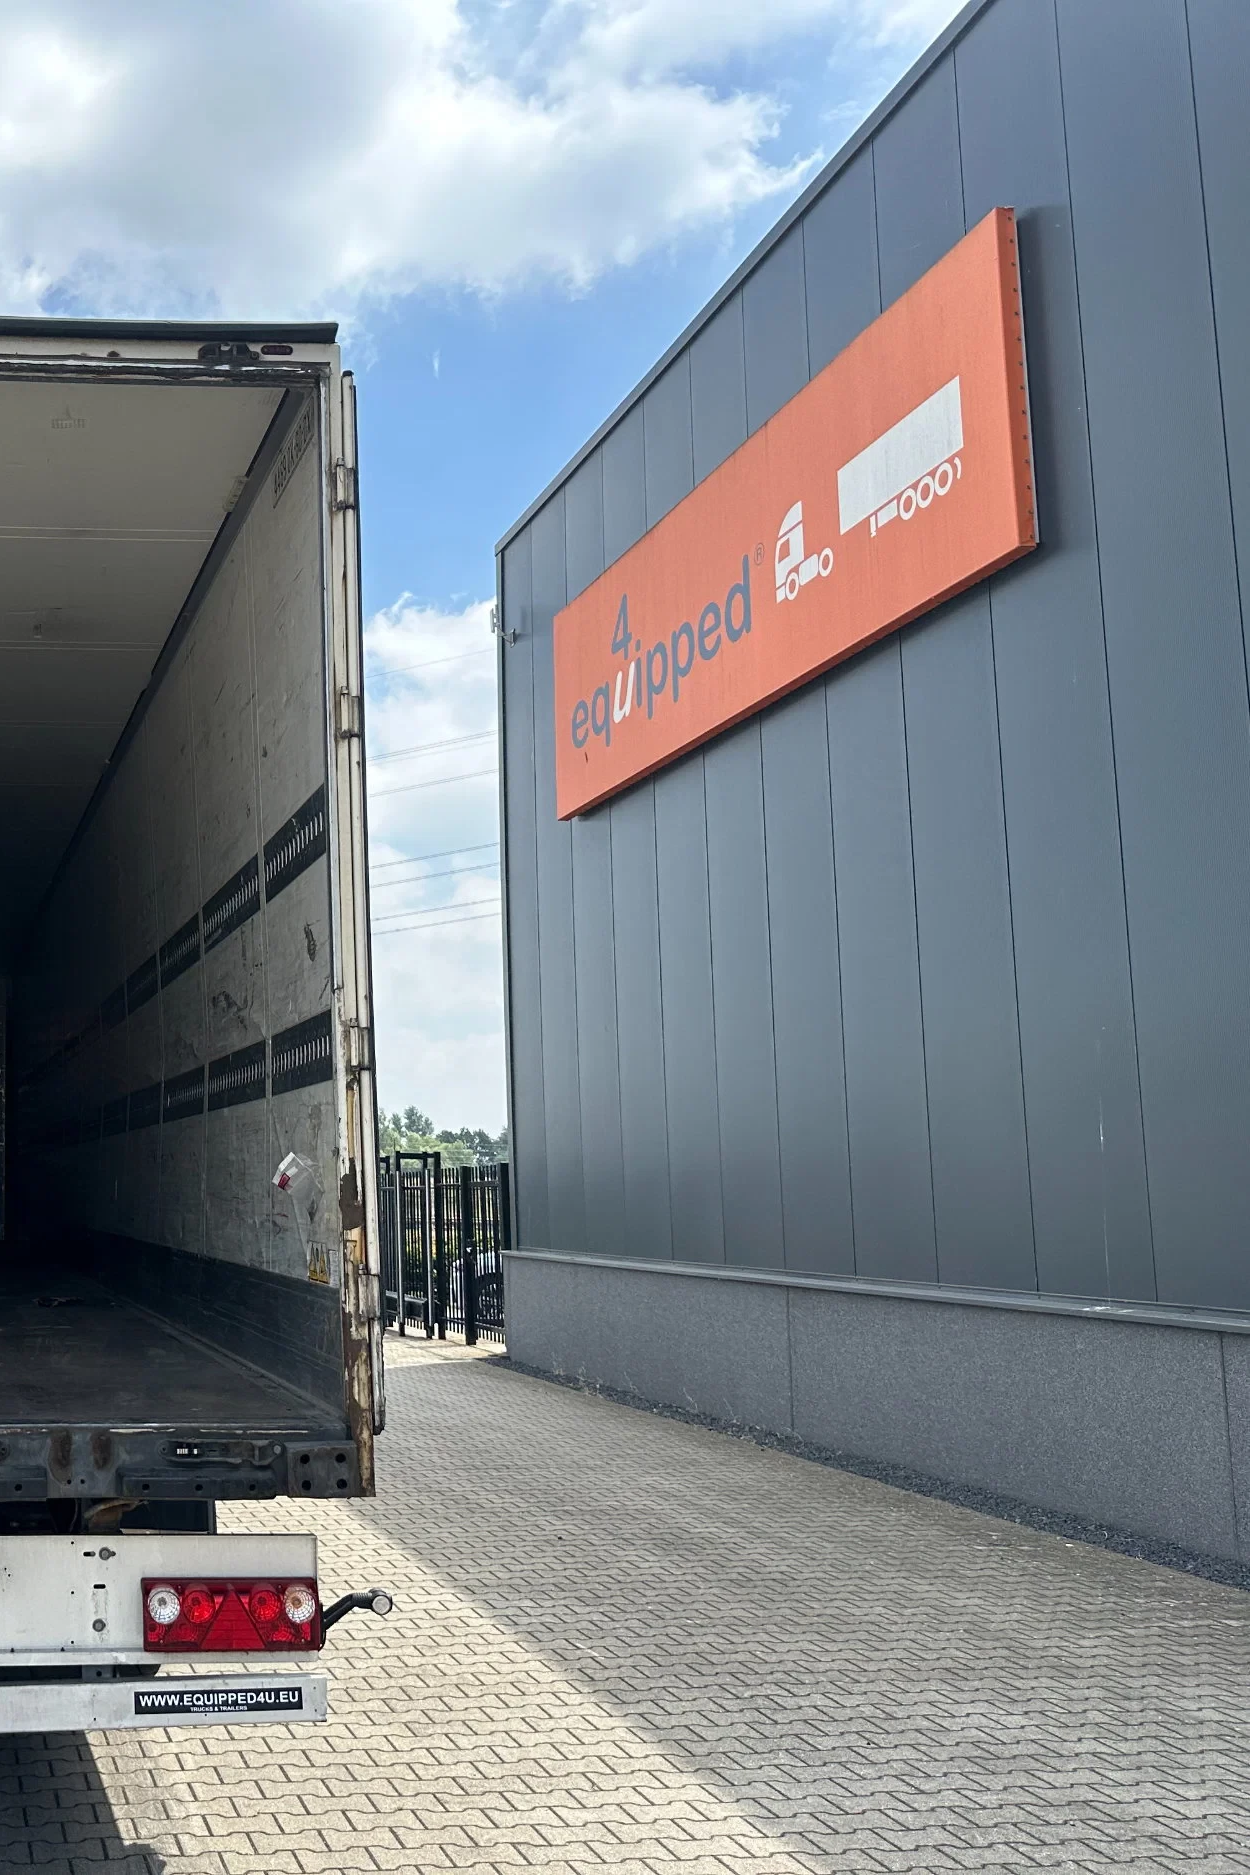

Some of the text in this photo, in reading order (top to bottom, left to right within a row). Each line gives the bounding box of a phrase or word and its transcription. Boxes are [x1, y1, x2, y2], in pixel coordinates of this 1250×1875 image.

[571, 554, 752, 749] equipped
[611, 593, 633, 661] 4
[139, 1690, 299, 1707] WWW.EQUIPPED4U.EU
